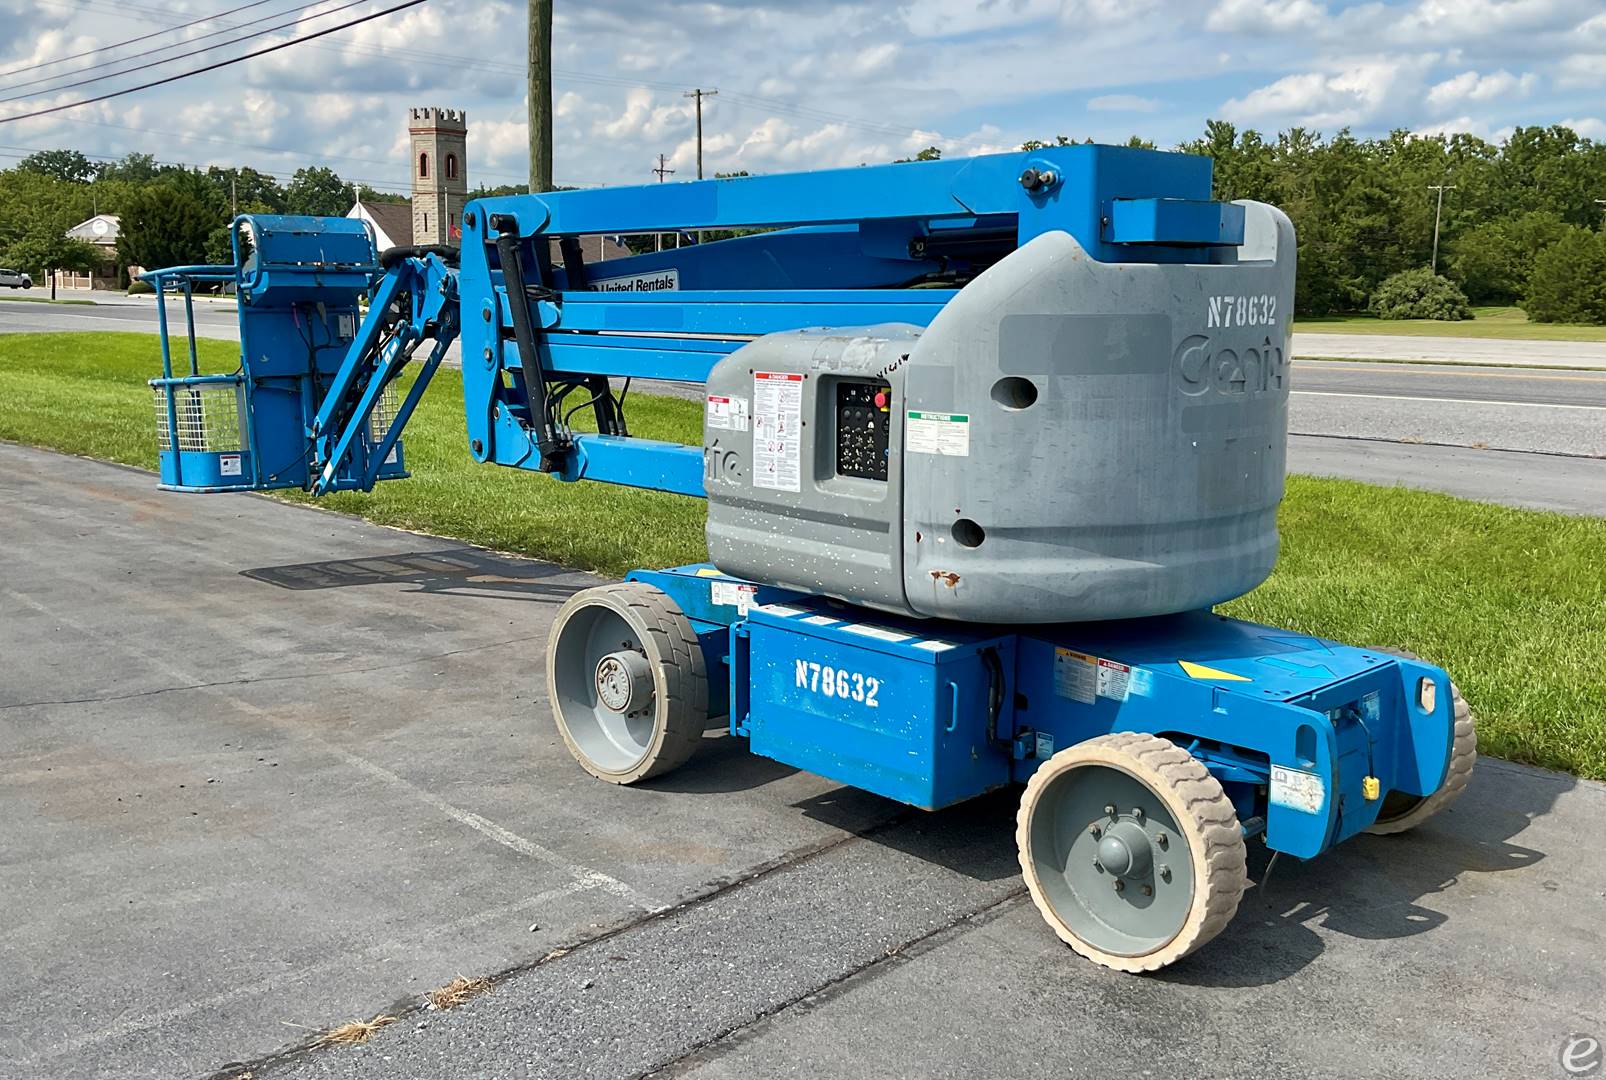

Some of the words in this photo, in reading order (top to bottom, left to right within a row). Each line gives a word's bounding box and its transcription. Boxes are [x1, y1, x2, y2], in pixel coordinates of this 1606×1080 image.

[601, 280, 634, 292] United
[636, 275, 674, 292] Rentals
[1207, 293, 1277, 328] N78632
[795, 658, 880, 708] N78632
